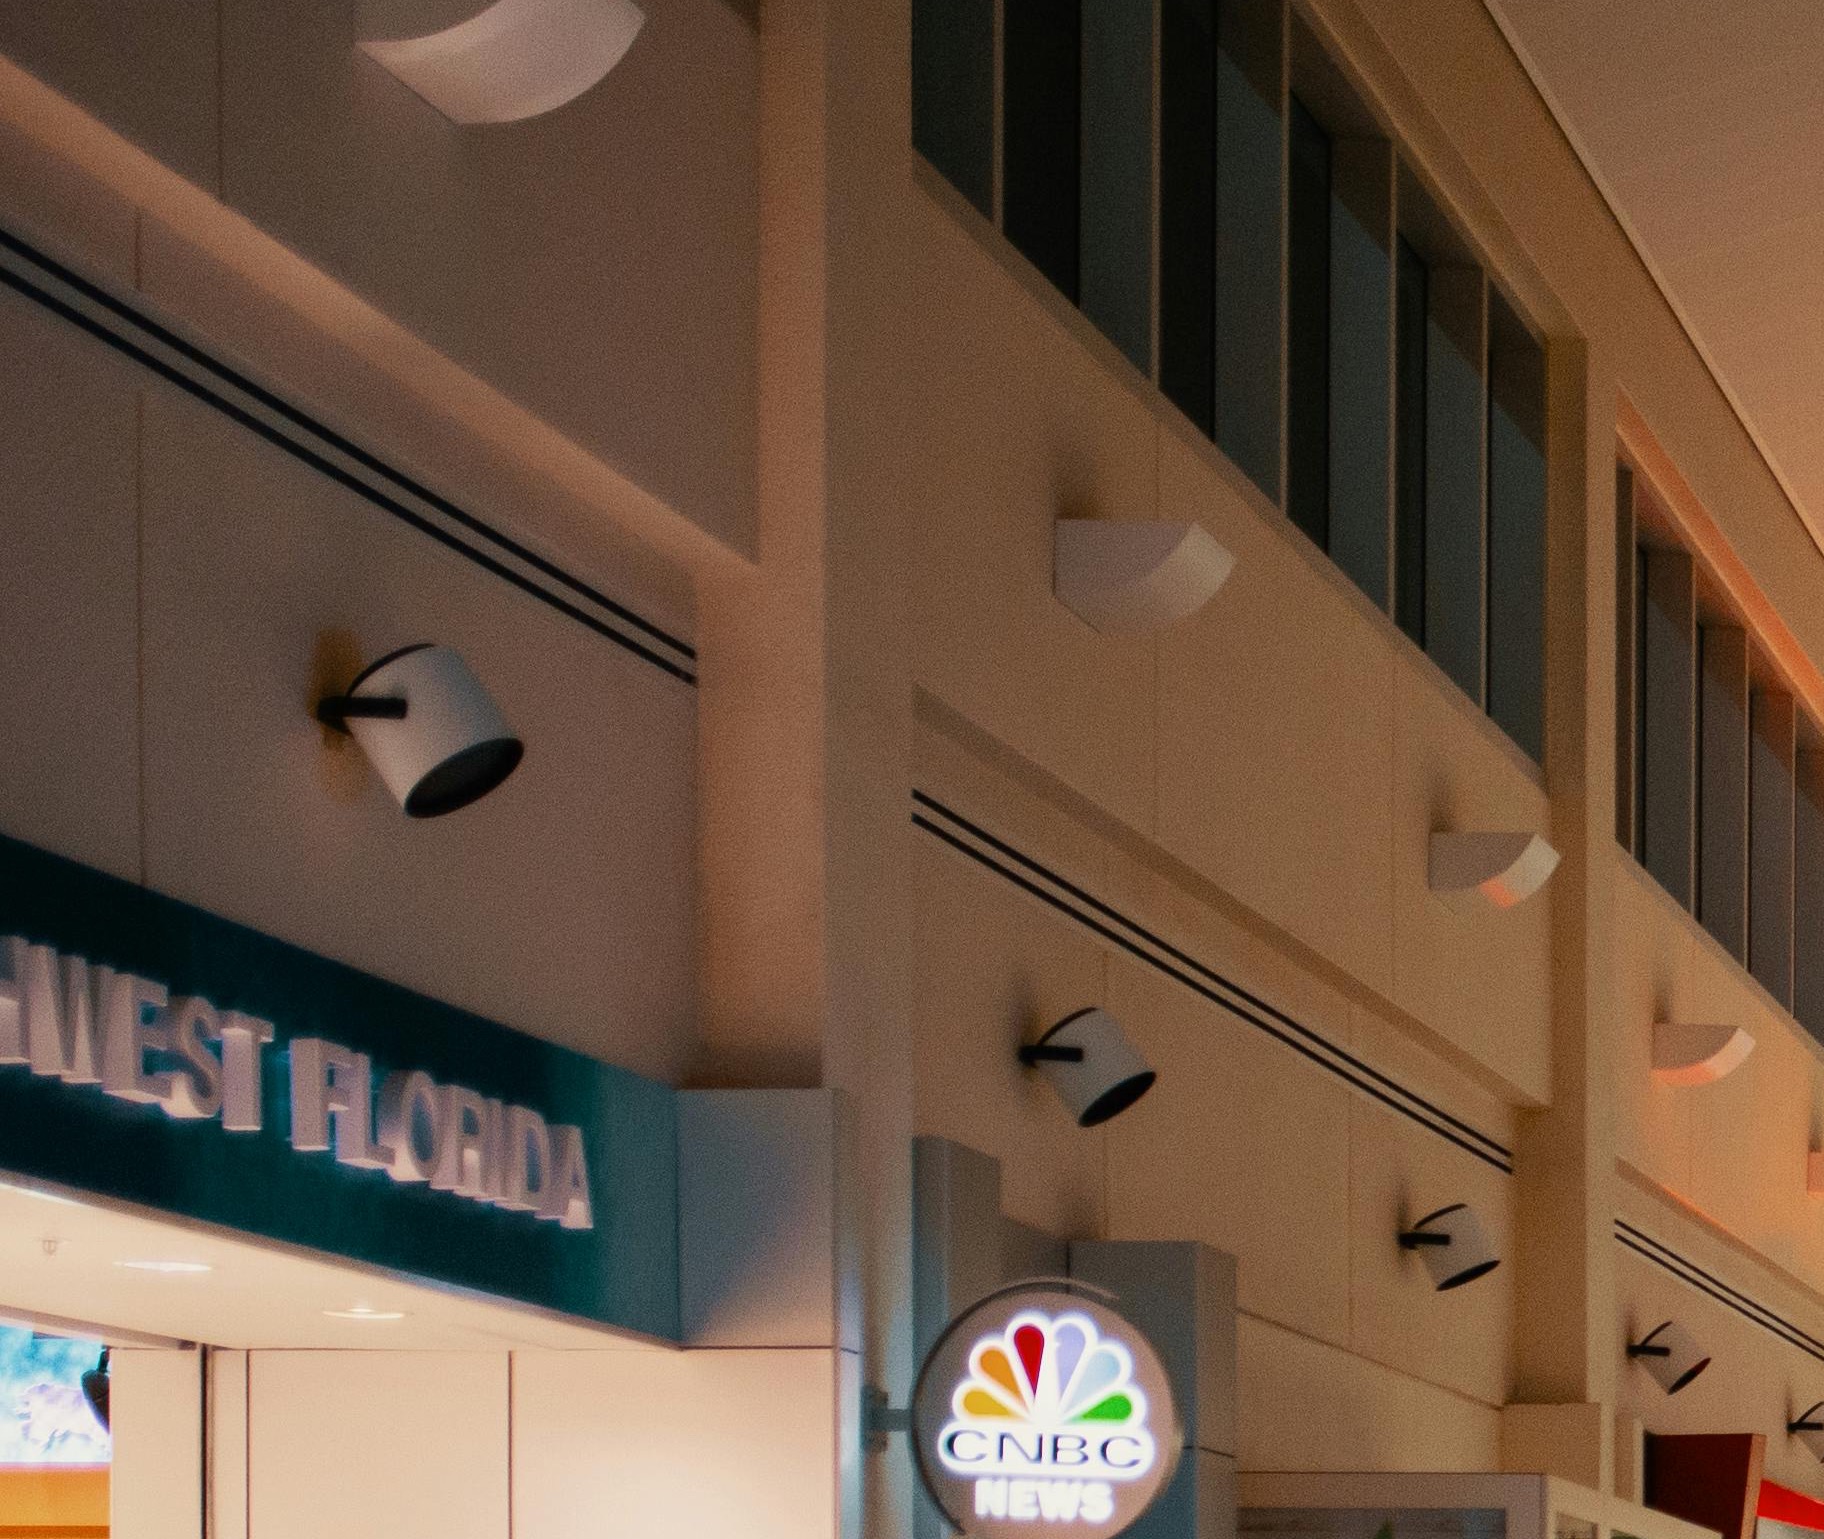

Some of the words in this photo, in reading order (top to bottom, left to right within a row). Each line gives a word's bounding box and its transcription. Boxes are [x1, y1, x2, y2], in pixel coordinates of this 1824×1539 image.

[289, 1037, 594, 1230] FLORIDA
[946, 1428, 1143, 1469] CNBC
[973, 1477, 1115, 1523] NEWS
